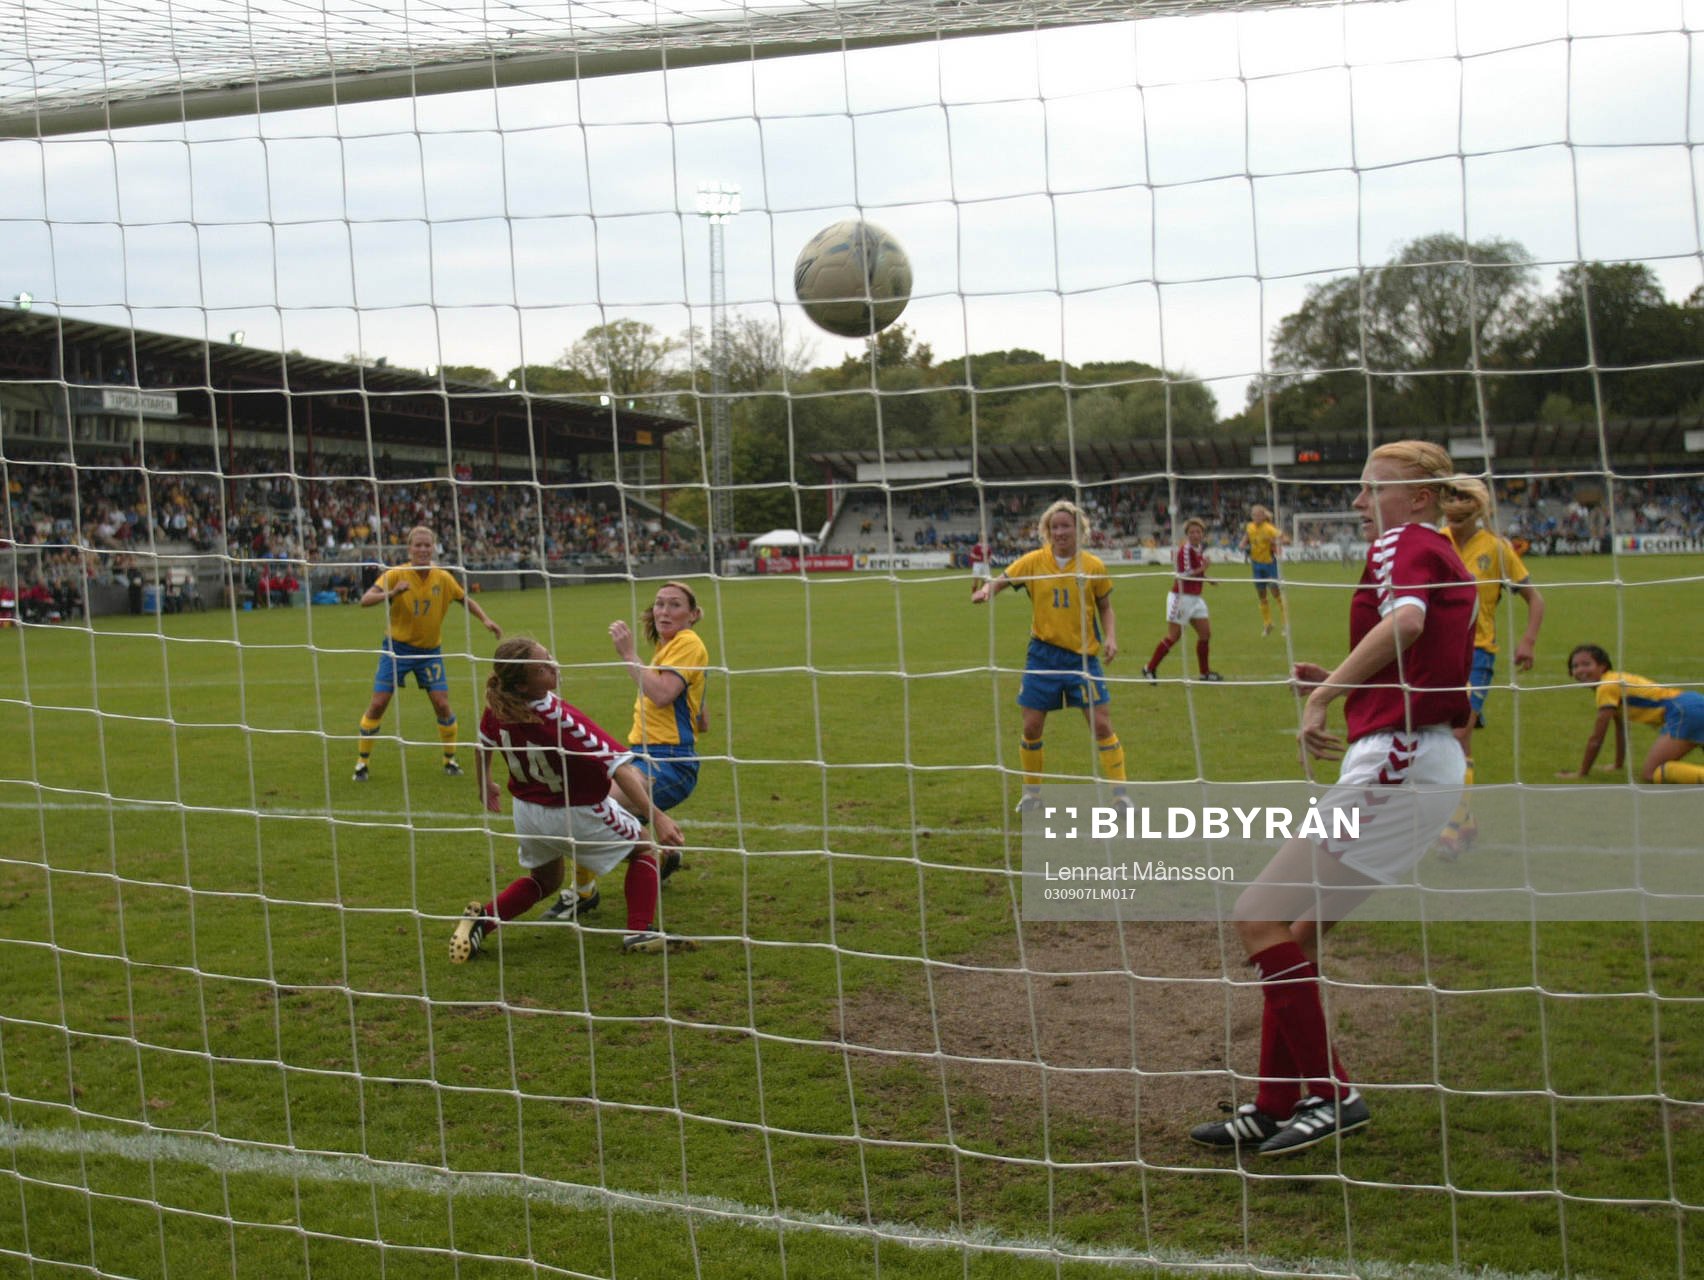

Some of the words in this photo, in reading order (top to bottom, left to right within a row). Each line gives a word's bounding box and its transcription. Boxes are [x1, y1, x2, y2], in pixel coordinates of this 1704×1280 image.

[1053, 588, 1070, 608] 11
[414, 600, 431, 617] 17
[425, 663, 441, 682] 17
[499, 728, 562, 793] 14
